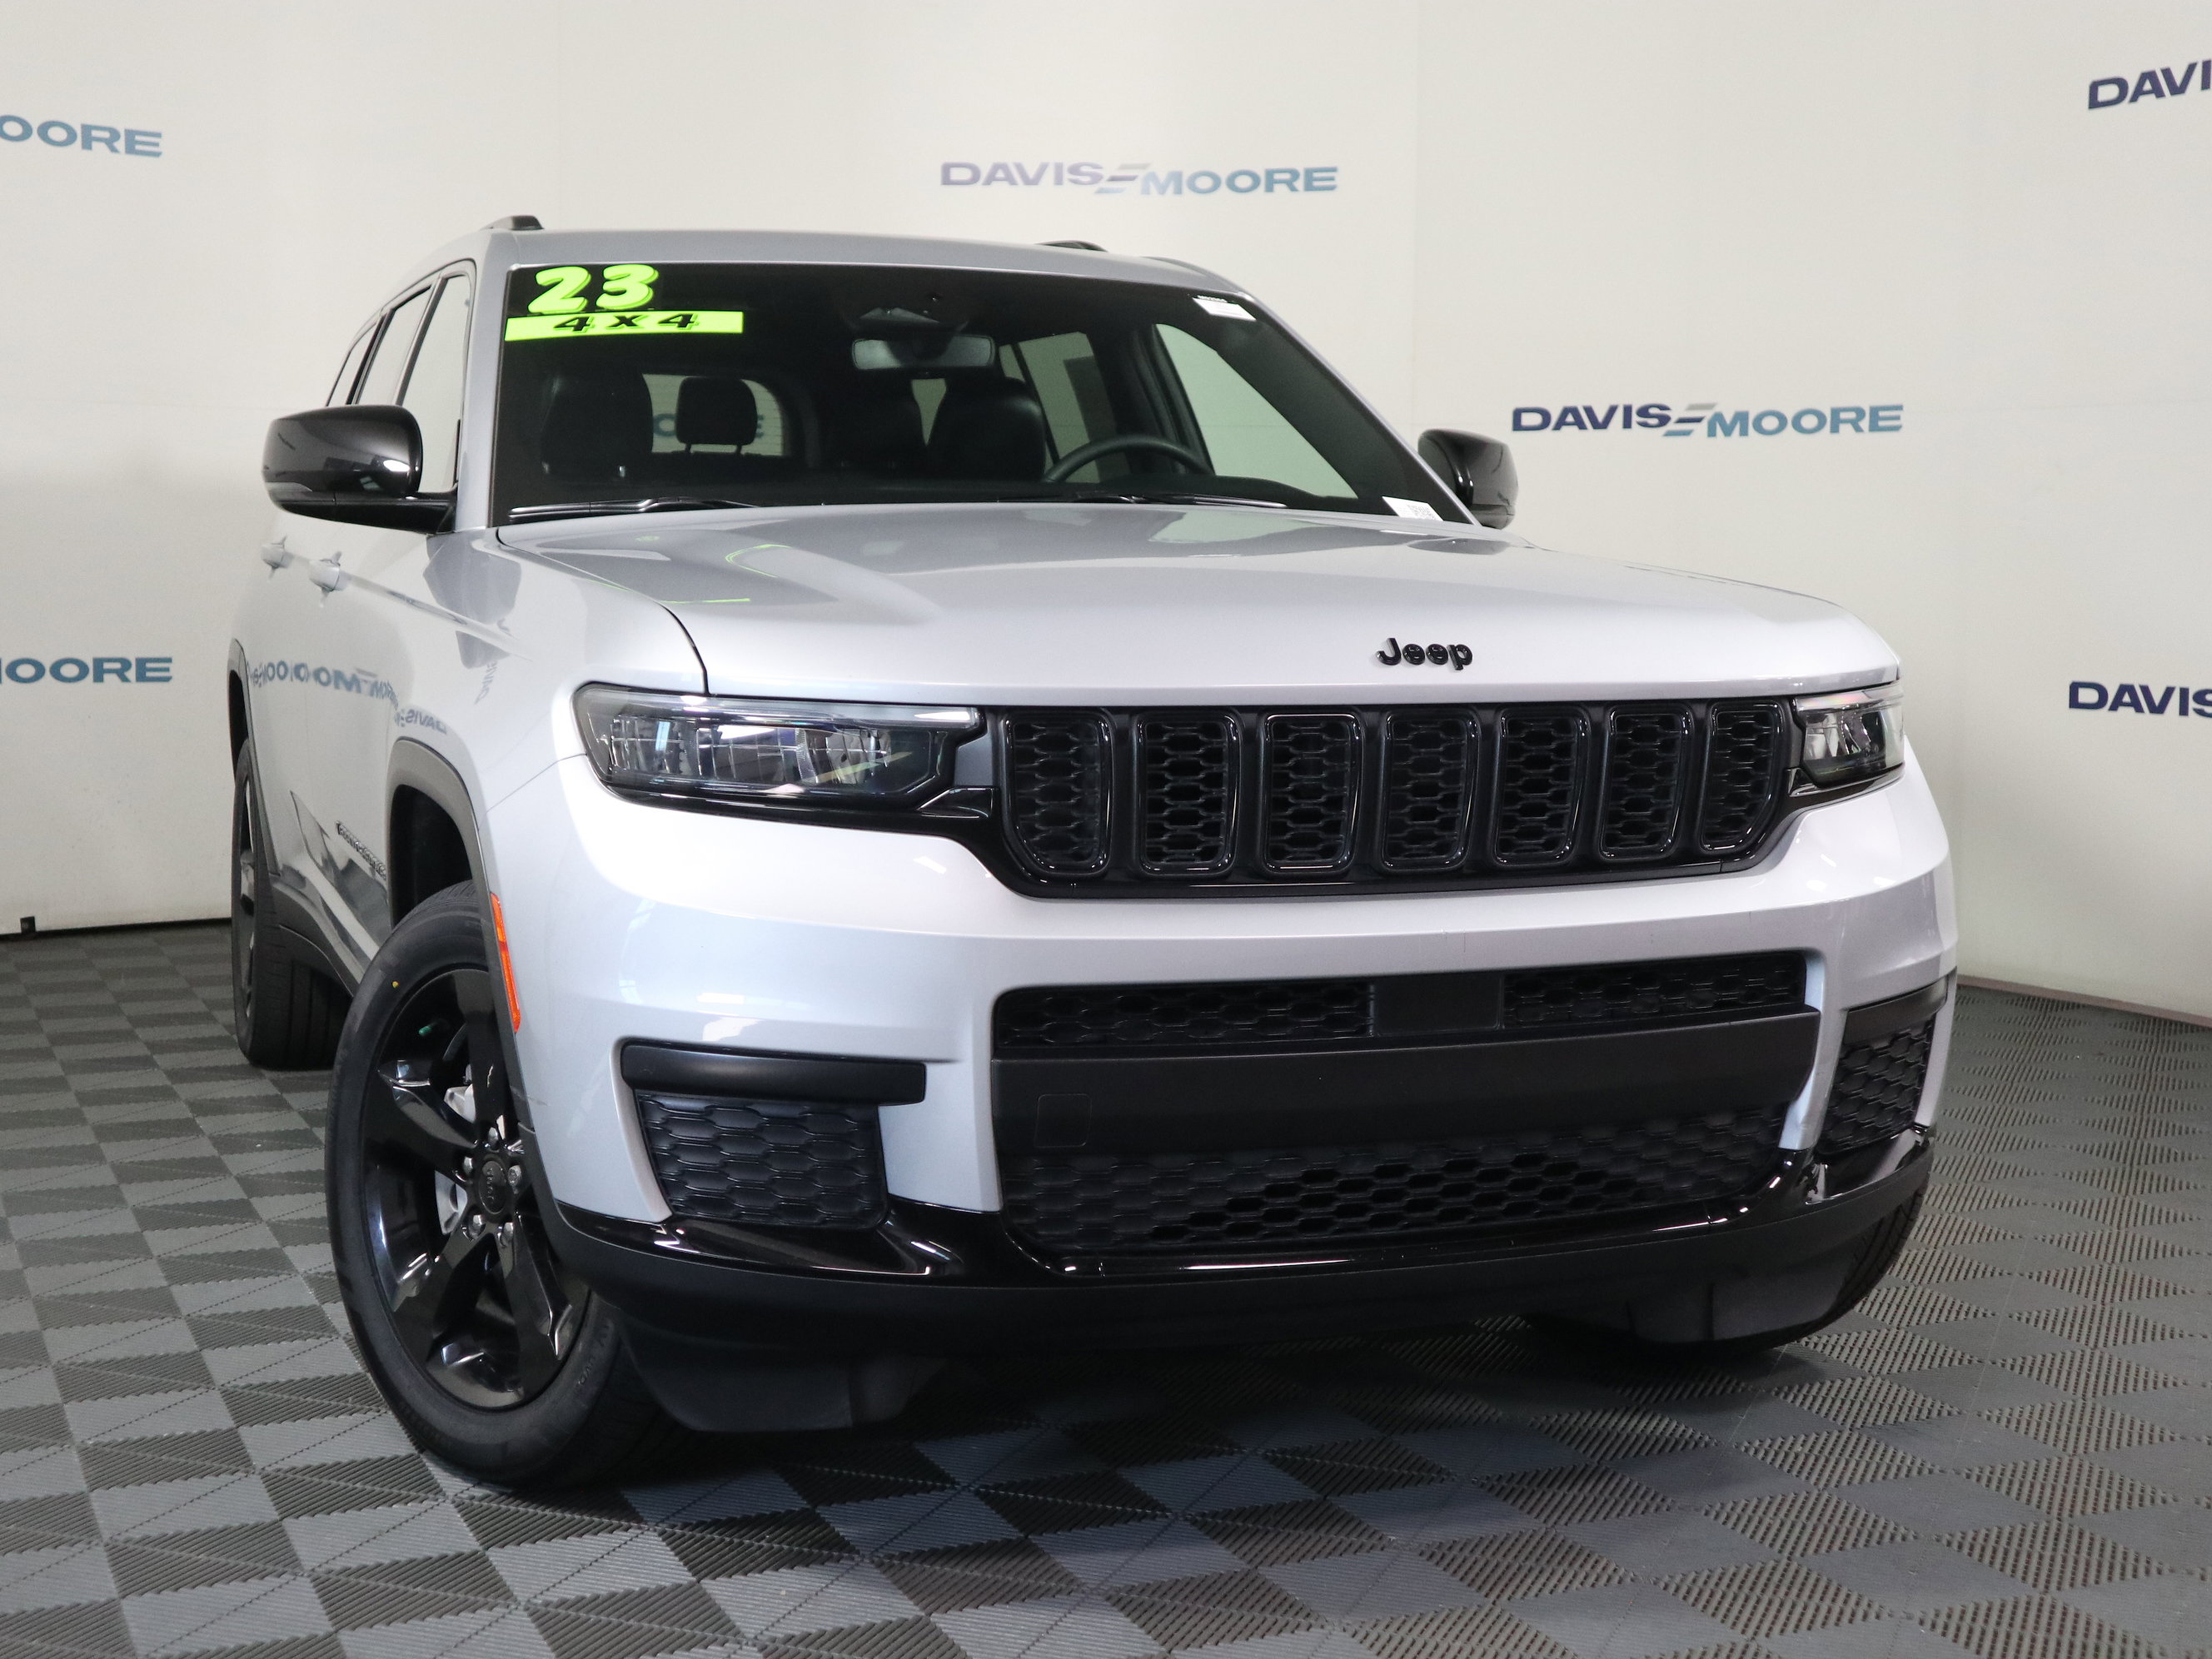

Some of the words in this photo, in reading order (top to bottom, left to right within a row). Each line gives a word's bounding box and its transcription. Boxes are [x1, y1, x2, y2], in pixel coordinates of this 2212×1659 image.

[2087, 58, 2212, 110] DAVI
[939, 161, 1104, 187] DAVIS
[1139, 166, 1338, 196] MOORE
[527, 263, 659, 315] 23
[1512, 403, 1672, 432] DAVIS
[1706, 404, 1905, 439] MOORE
[0, 656, 173, 685] OORE
[1375, 637, 1473, 671] Jeep
[2069, 680, 2212, 720] DAVIS
